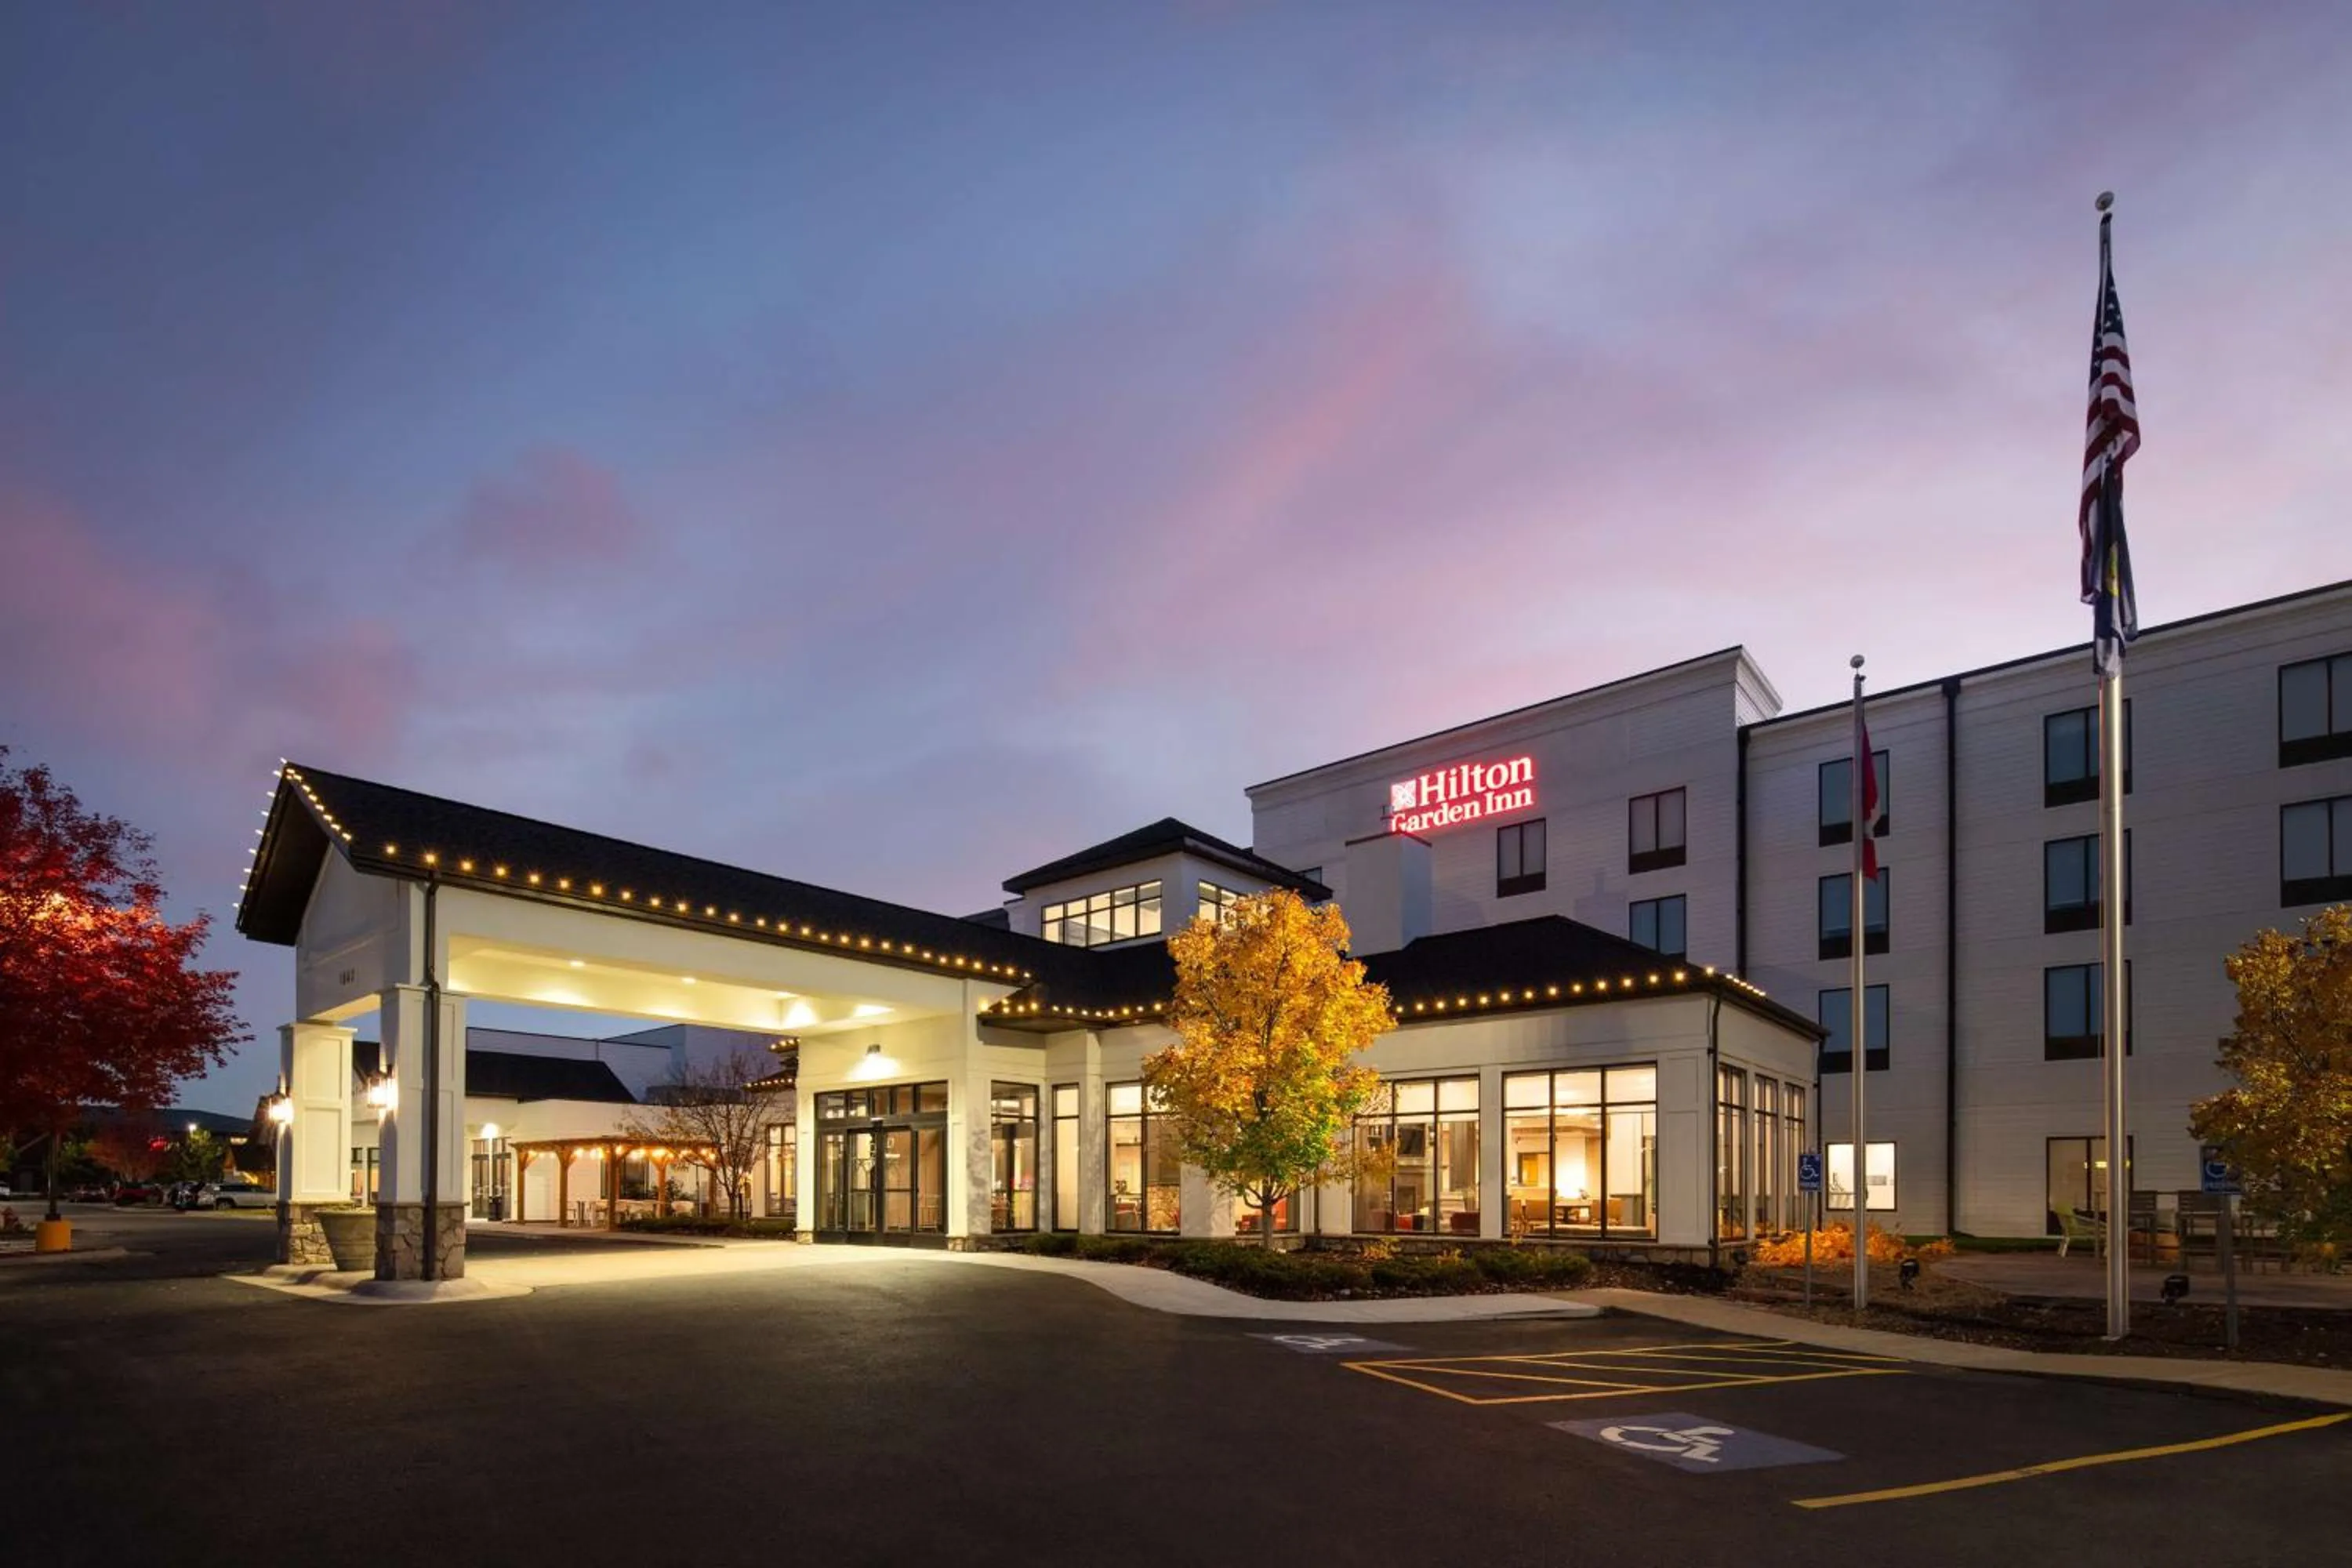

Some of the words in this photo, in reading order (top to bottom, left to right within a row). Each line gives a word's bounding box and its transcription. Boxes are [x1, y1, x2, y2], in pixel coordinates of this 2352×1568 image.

[1419, 757, 1534, 806] Hilton
[1392, 800, 1481, 833] Garden
[1484, 788, 1534, 815] Inn
